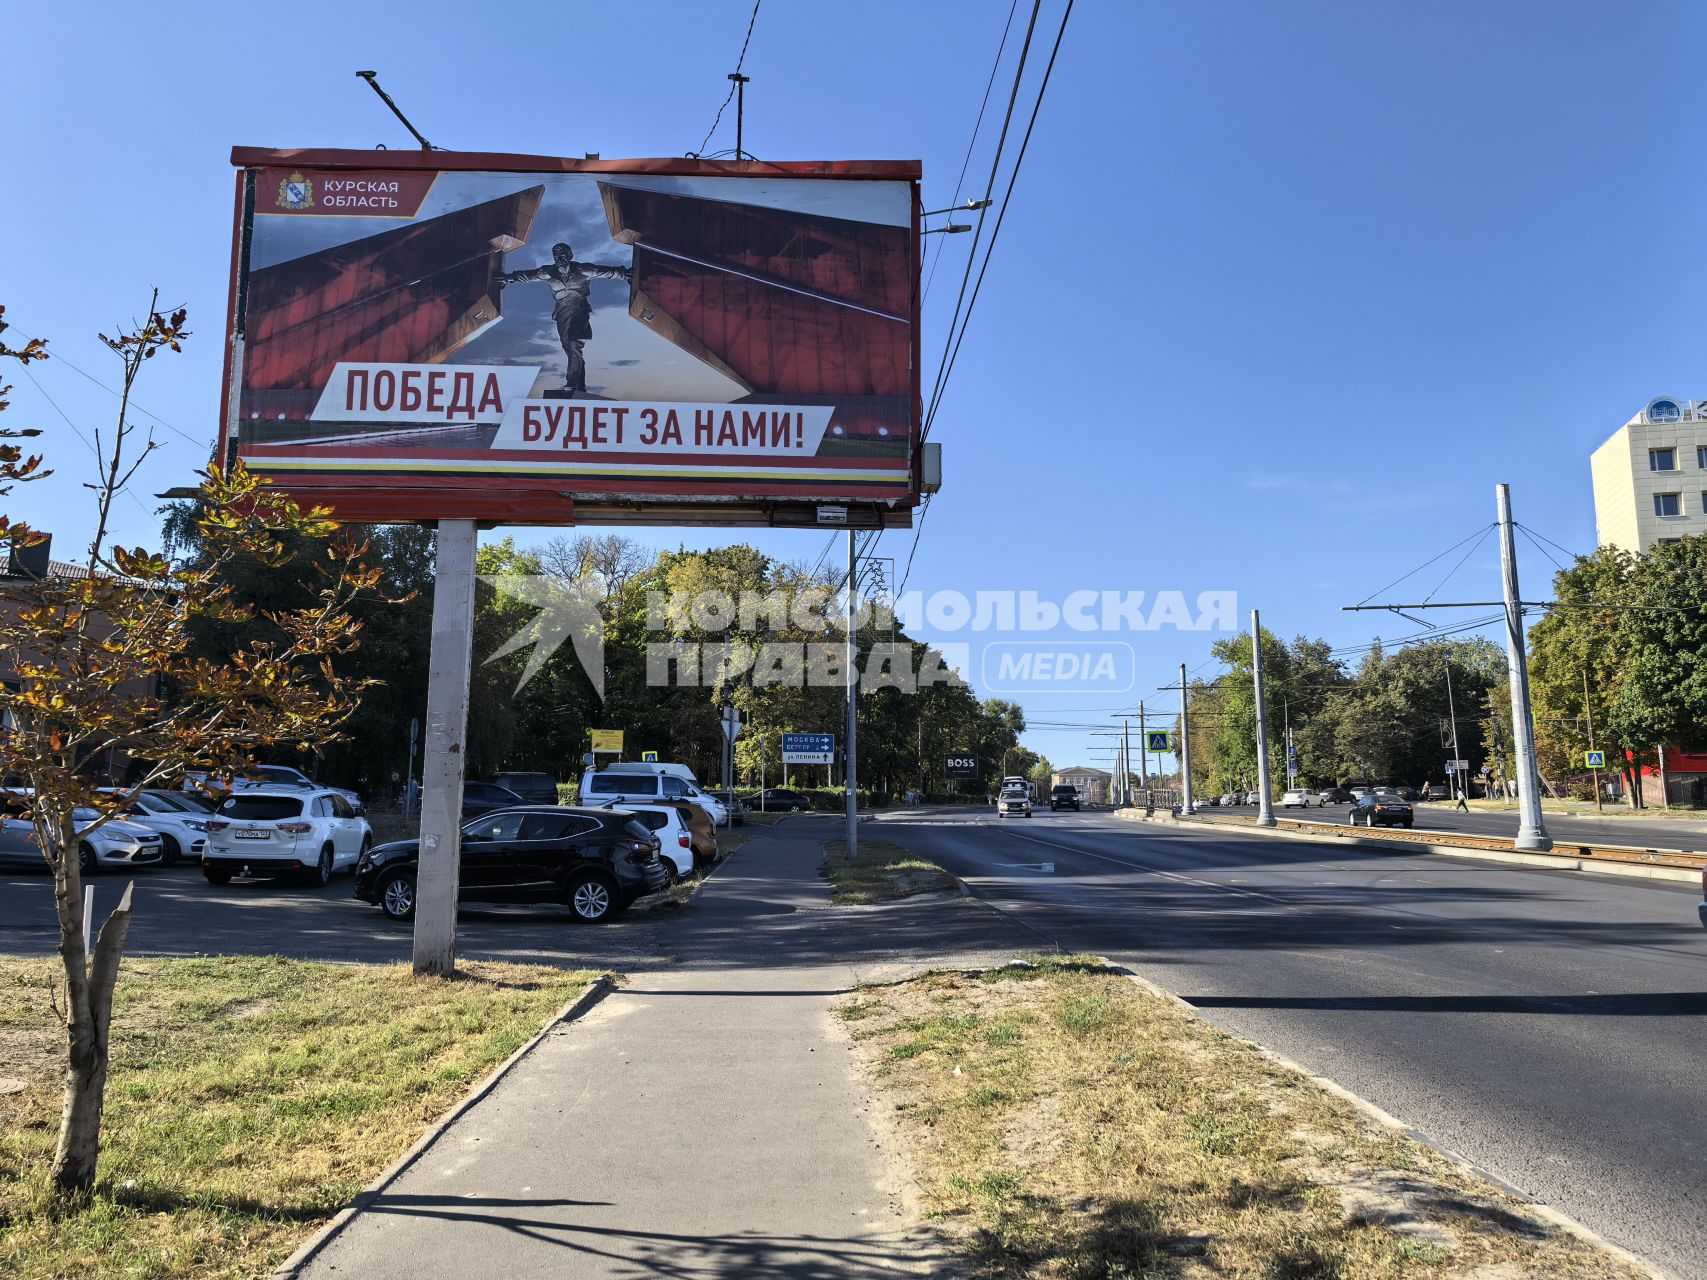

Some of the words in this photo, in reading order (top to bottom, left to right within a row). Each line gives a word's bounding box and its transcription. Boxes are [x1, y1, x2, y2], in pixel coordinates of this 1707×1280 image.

[324, 180, 398, 193] КУРСКАЯ
[323, 196, 398, 208] ОБЛАСТЬ
[345, 369, 503, 420] ПОБЕДА
[522, 405, 629, 449] БУДЕТ
[639, 407, 683, 446] ЗА
[694, 409, 805, 449] НАМИ!
[947, 758, 975, 767] BOSS
